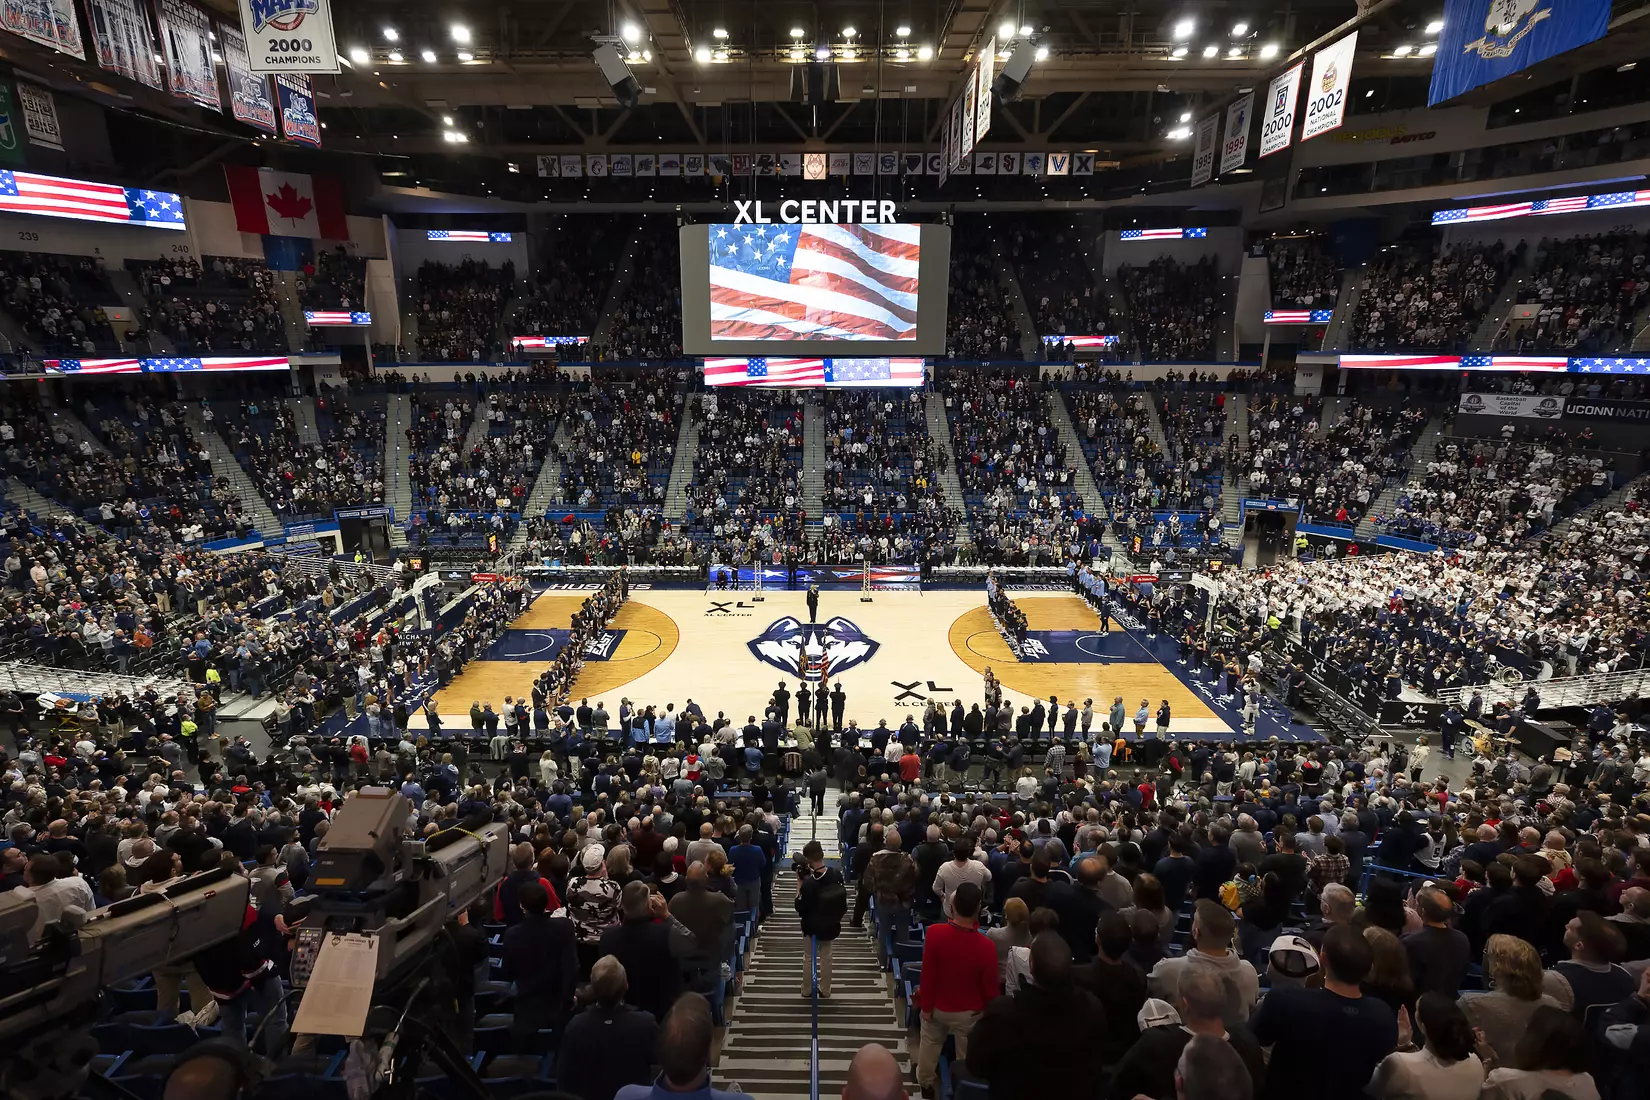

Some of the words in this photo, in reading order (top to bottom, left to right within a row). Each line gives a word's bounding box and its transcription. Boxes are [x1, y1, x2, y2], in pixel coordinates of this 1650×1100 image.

[268, 38, 312, 52] 2000
[265, 56, 321, 64] CHAMPIONS
[1308, 88, 1343, 117] 2002
[1263, 112, 1292, 138] 2000
[1310, 110, 1336, 126] NATIONAL
[1306, 118, 1338, 136] CHAMPIONS
[1225, 136, 1245, 156] 1999
[1265, 132, 1286, 145] NATIONAL
[1262, 140, 1287, 154] CHAMPIONS
[1052, 156, 1066, 172] V
[1076, 156, 1092, 172] X
[1196, 152, 1212, 170] 1995
[734, 200, 771, 224] XL
[779, 200, 897, 224] CENTER
[18, 231, 39, 241] 239
[172, 244, 189, 253] 240
[1566, 404, 1614, 416] UCONN
[706, 602, 754, 613] XL
[592, 632, 614, 656] EAST
[1282, 640, 1296, 654] XL
[1312, 659, 1327, 674] XL
[890, 681, 954, 701] XL
[1349, 683, 1365, 699] XL
[1403, 705, 1428, 719] XL
